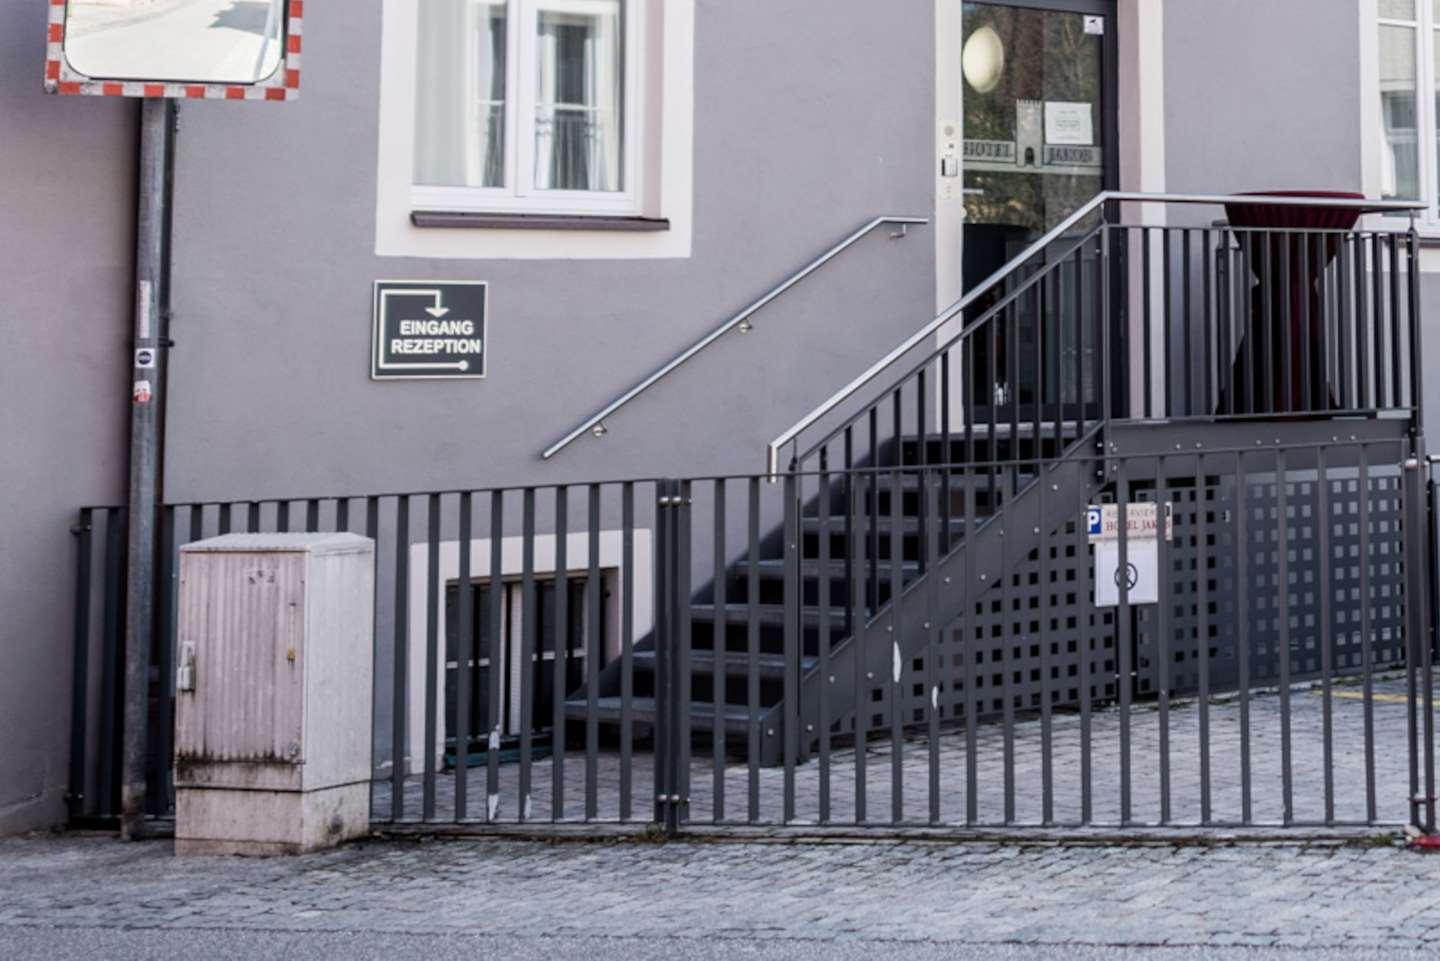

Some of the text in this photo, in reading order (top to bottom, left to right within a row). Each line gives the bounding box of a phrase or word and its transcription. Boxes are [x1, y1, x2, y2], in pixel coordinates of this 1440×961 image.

[962, 141, 1013, 158] HOTEL
[399, 320, 474, 335] EINGANG
[391, 339, 481, 354] REZEPTION
[1088, 511, 1100, 534] P
